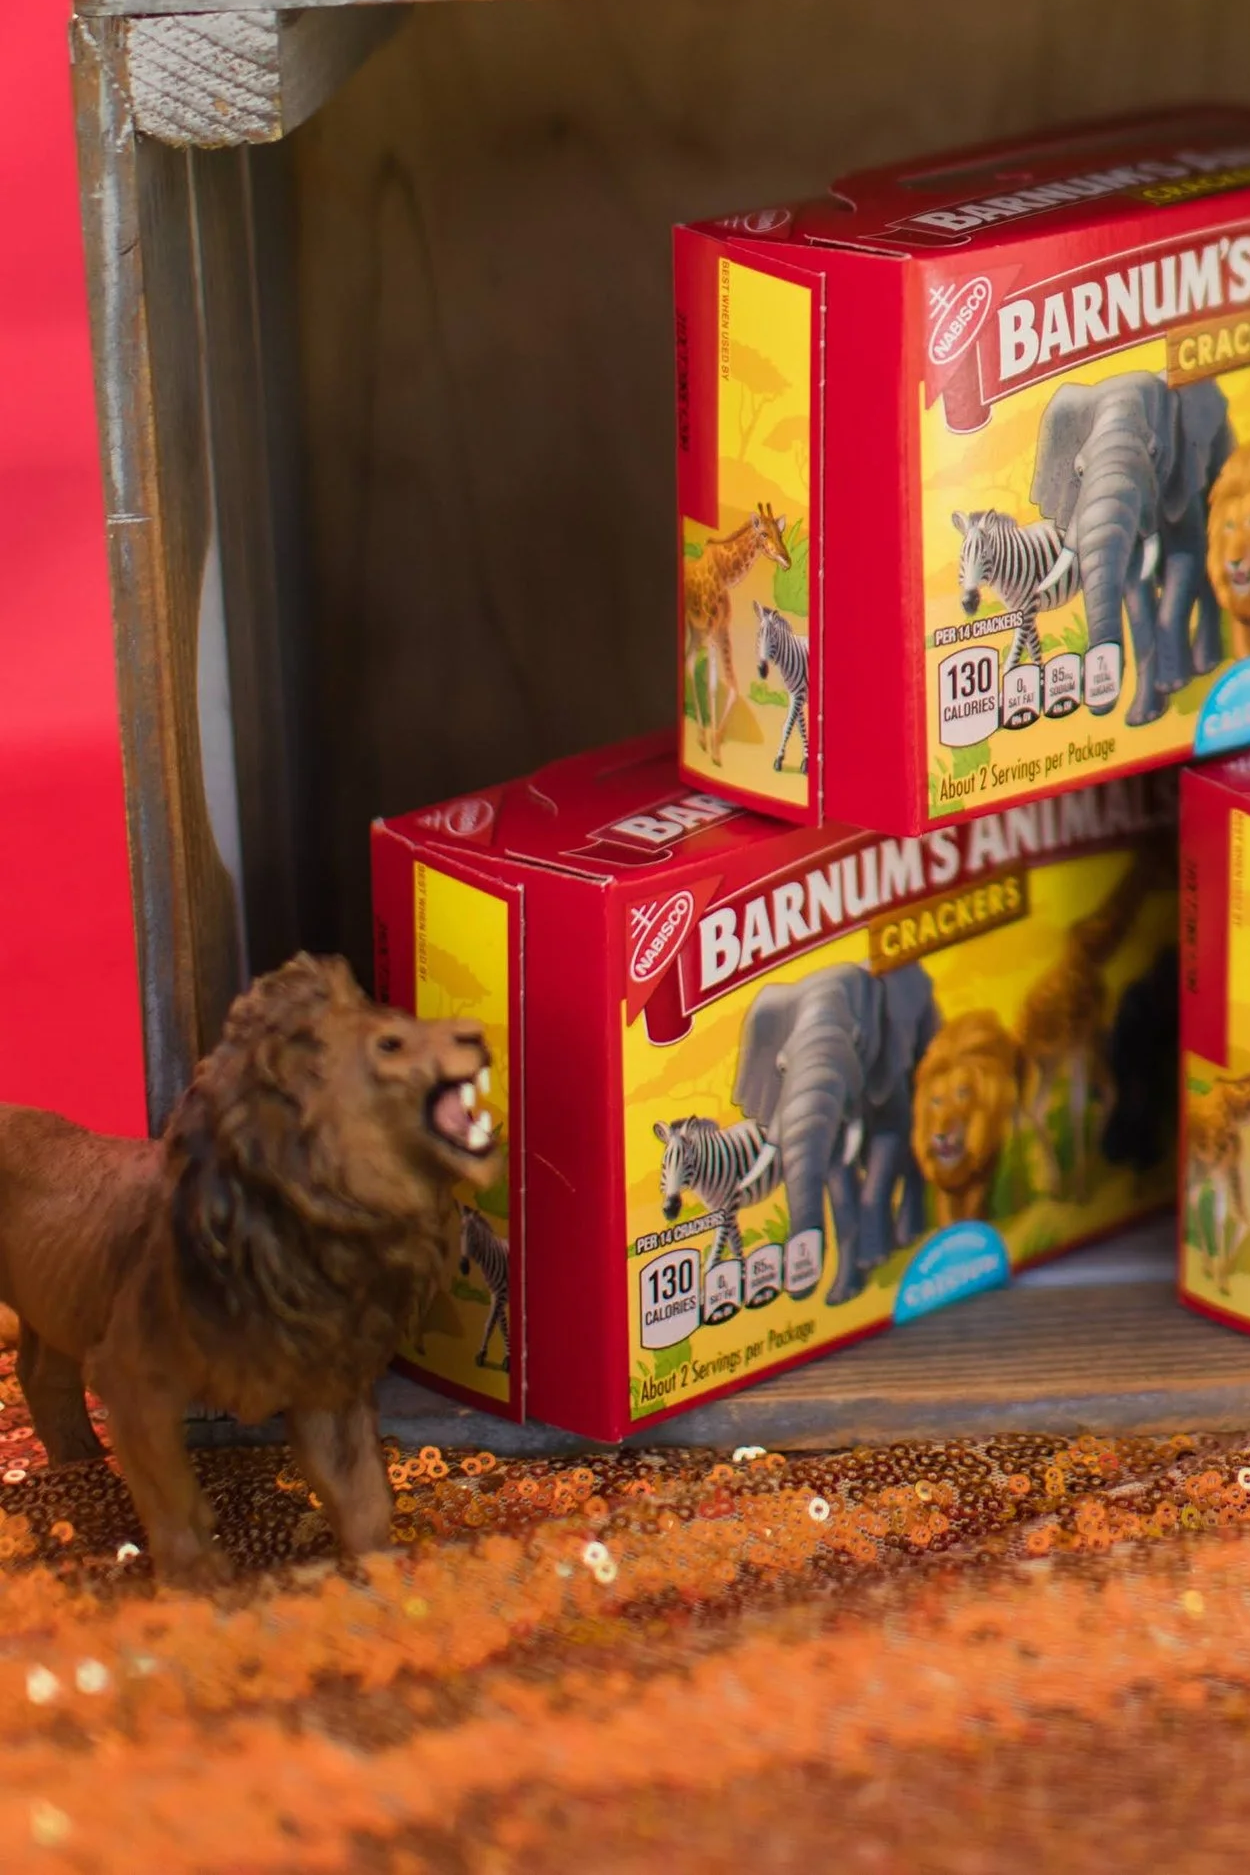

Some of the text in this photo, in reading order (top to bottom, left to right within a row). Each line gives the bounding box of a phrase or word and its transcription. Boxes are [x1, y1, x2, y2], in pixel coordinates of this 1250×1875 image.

[721, 261, 730, 291] BEST
[721, 294, 730, 329] WHEN
[933, 286, 987, 358] NABISCO
[935, 611, 1024, 646] PER 14 CRACKERS
[947, 656, 992, 700] 130
[943, 696, 996, 722] CALORIES
[940, 734, 1116, 801] About 2 Servings per Package
[698, 824, 961, 992] BARNUMS
[879, 876, 1021, 957] CRACKERS
[634, 897, 689, 976] NABISCO
[636, 1236, 658, 1254] PER
[648, 1258, 693, 1305] 130
[644, 1295, 697, 1326] CALORIES
[640, 1374, 677, 1404] About
[680, 1366, 689, 1388] 2
[692, 1351, 742, 1383] Servings
